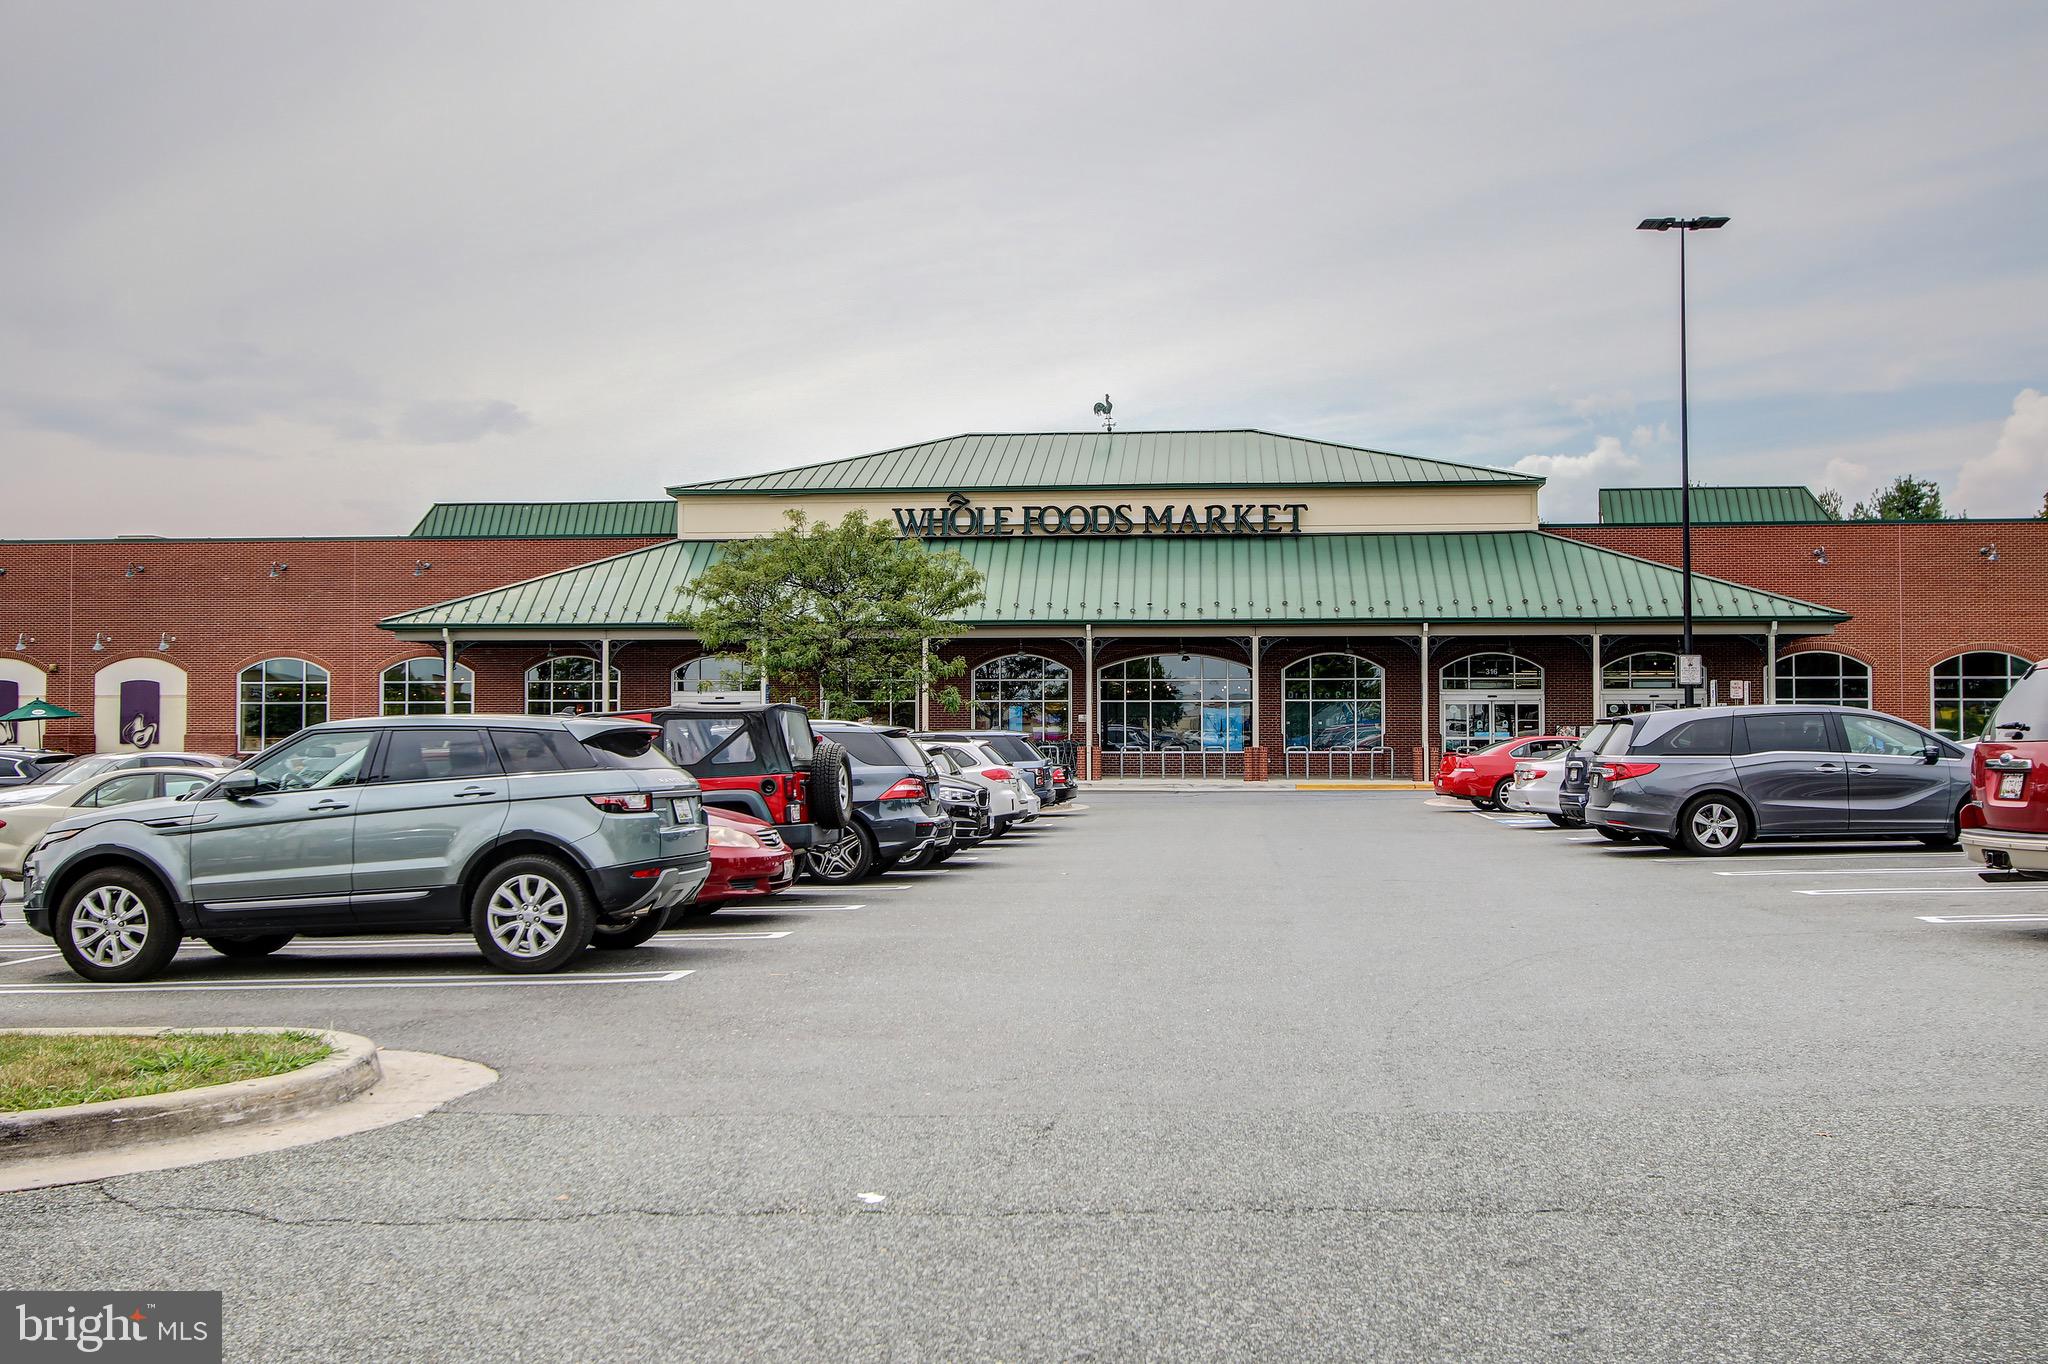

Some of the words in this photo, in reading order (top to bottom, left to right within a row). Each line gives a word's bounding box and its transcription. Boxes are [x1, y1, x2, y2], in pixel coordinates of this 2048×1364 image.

[892, 497, 1014, 537] WHOLE
[1022, 503, 1134, 535] FOODS
[1142, 503, 1309, 534] MARKET
